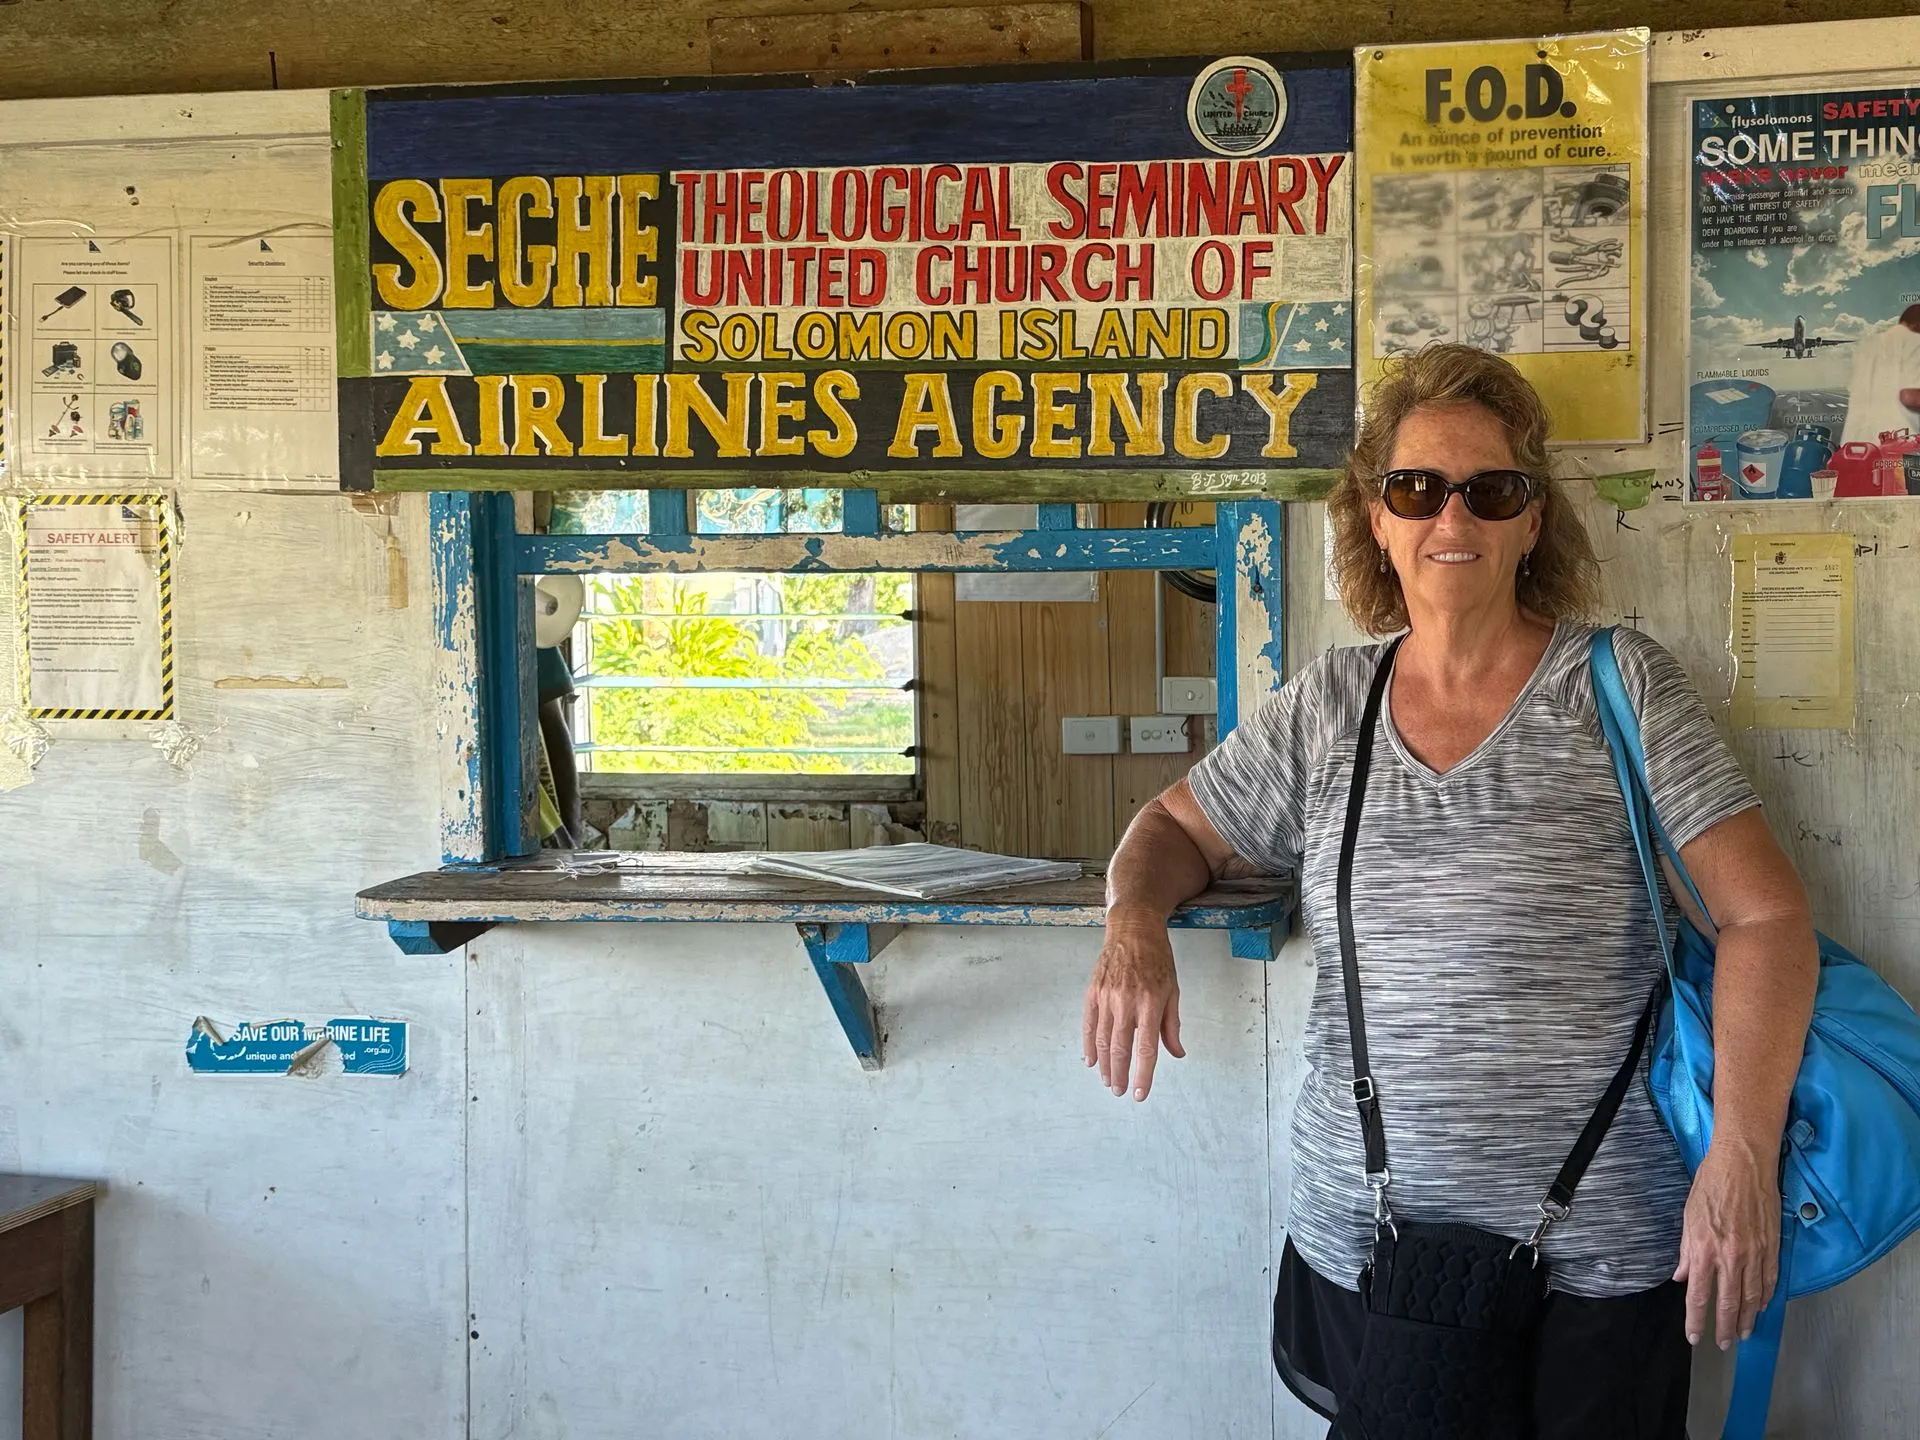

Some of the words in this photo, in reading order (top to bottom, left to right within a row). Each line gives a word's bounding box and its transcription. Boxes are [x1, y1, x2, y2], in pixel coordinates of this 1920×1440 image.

[1425, 64, 1577, 123] F.O.D.
[1203, 110, 1233, 118] UNITED
[1243, 110, 1274, 118] CHURCH
[1823, 98, 1920, 121] SAFETY
[1731, 114, 1813, 129] flysolomons
[1400, 131, 1421, 147] An
[1429, 131, 1480, 147] ounce
[1487, 127, 1504, 143] of
[1510, 124, 1603, 145] prevention
[1701, 131, 1815, 166] SOME
[1823, 127, 1920, 159] THIN
[1411, 149, 1461, 166] worth
[1468, 151, 1478, 163] a
[1485, 145, 1536, 165] pound
[1544, 143, 1561, 159] of
[1567, 145, 1611, 159] cure.
[1701, 167, 1773, 186] were
[1779, 165, 1849, 182] never
[675, 165, 1022, 243] THEOLOGICAL
[1046, 156, 1345, 240] SEMINARY
[1702, 194, 1711, 203] To
[1747, 191, 1780, 202] passenger
[1812, 187, 1825, 196] and
[1828, 187, 1854, 197] security
[1702, 204, 1717, 214] AND
[1720, 204, 1728, 213] IN
[1732, 203, 1745, 213] THE
[1750, 202, 1781, 212] INTEREST
[1782, 201, 1792, 210] OF
[1795, 200, 1822, 209] SAFETY
[1702, 217, 1713, 226] WE
[1716, 216, 1735, 225] HAVE
[1739, 215, 1752, 223] THE
[1755, 213, 1776, 222] RIGHT
[1778, 213, 1788, 221] TO
[1702, 228, 1720, 237] DENY
[1724, 226, 1759, 236] BOARDING
[1771, 226, 1783, 234] you
[1787, 225, 1798, 233] are
[372, 174, 660, 310] SEGHE
[1701, 240, 1720, 249] under
[1724, 239, 1734, 248] the
[1737, 237, 1767, 247] influence
[1769, 236, 1777, 245] of
[1780, 234, 1804, 244] alcohol
[681, 247, 887, 306] UNITED
[915, 243, 1155, 306] CHURCH
[1191, 240, 1274, 301] OF
[680, 308, 978, 362] SOLOMON
[1000, 306, 1229, 360] ISLAND
[1696, 369, 1738, 379] FLAMMABLE
[1742, 368, 1769, 377] LIQUIDS
[376, 369, 860, 458] AIRLINES
[887, 370, 1318, 460] AGENCY
[1784, 414, 1828, 424] FLAMMABLE
[1830, 414, 1845, 423] GAS
[1694, 424, 1740, 434] COMPRESSED
[1743, 423, 1758, 432] GAS
[1240, 471, 1267, 486] 2013
[47, 533, 95, 544] SAFETY
[97, 533, 138, 544] ALERT
[233, 1026, 267, 1042] SAVE
[271, 1026, 299, 1041] OUR
[361, 1027, 391, 1042] LIFE
[246, 1052, 277, 1061] unique
[364, 1047, 391, 1055] .org.au
